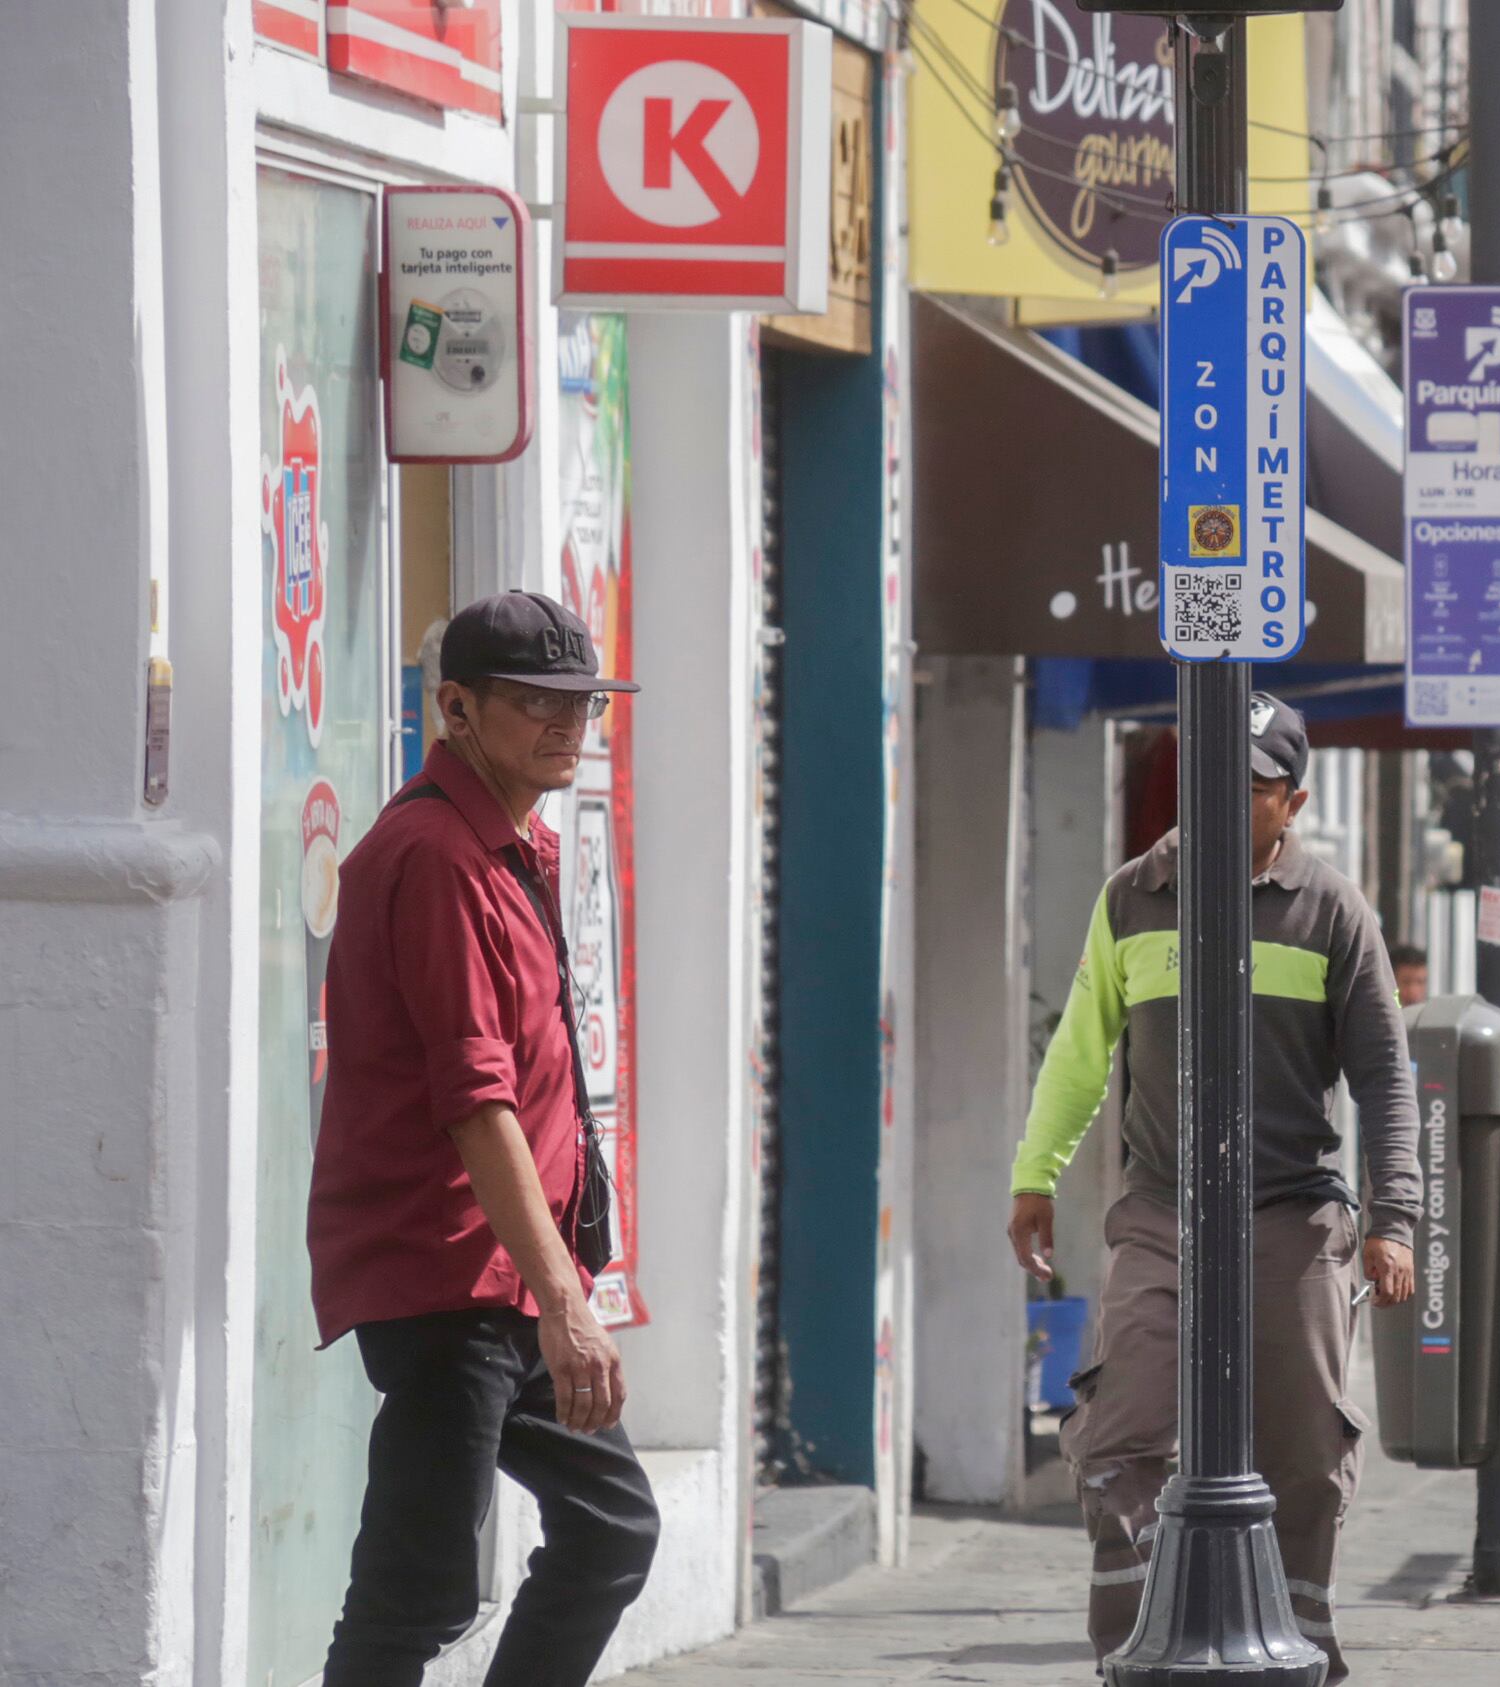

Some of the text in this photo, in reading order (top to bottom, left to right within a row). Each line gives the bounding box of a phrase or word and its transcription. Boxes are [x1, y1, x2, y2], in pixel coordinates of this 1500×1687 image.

[1070, 131, 1174, 239] gourm
[407, 217, 453, 230] REALIZA
[401, 262, 512, 276] tarjeta inteligente
[420, 247, 493, 262] Tu pago con
[1258, 227, 1288, 648] PARQUÍMETROS
[1425, 1099, 1446, 1169] rumbo
[1429, 1173, 1444, 1220] con
[1429, 1222, 1449, 1240] y
[1422, 1242, 1448, 1329] Contigo
